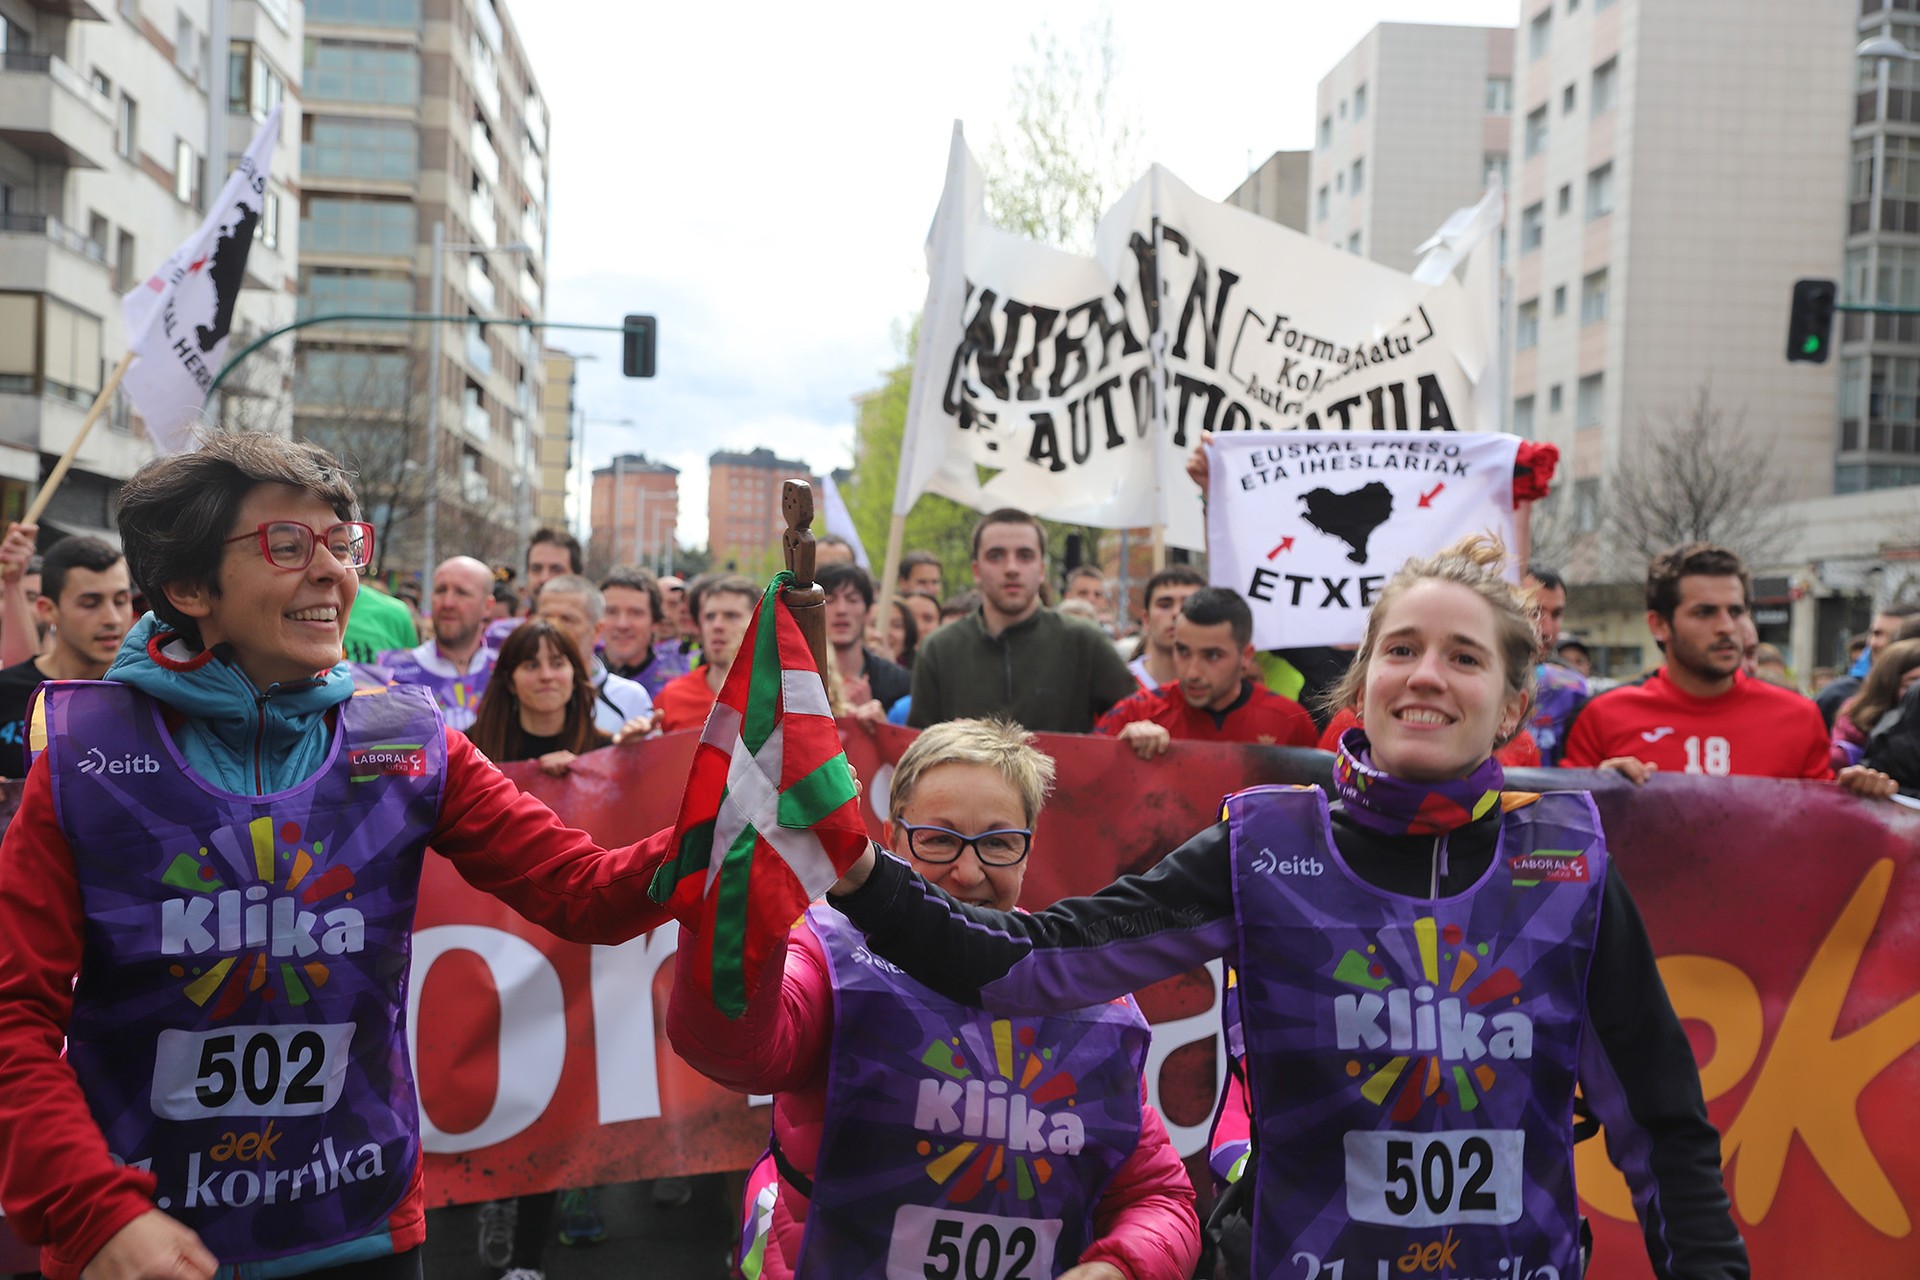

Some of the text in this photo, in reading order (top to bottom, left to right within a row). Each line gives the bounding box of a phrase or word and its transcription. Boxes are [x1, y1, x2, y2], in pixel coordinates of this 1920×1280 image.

[1241, 454, 1471, 491] ETA IHESLARIAK
[1248, 567, 1386, 608] ETXE
[109, 755, 160, 775] eitb
[353, 754, 408, 765] LABORAL
[1684, 735, 1731, 776] 18
[1279, 856, 1325, 877] eitb
[1513, 859, 1569, 870] LABORAL
[161, 885, 366, 958] Klika
[1333, 985, 1534, 1062] Klika
[194, 1031, 327, 1110] 502
[914, 1078, 1086, 1156] Klika
[209, 1119, 283, 1162] aek
[184, 1136, 386, 1209] korrika
[1384, 1137, 1498, 1216] 502
[922, 1219, 1037, 1280] 502
[1397, 1228, 1461, 1273] aek
